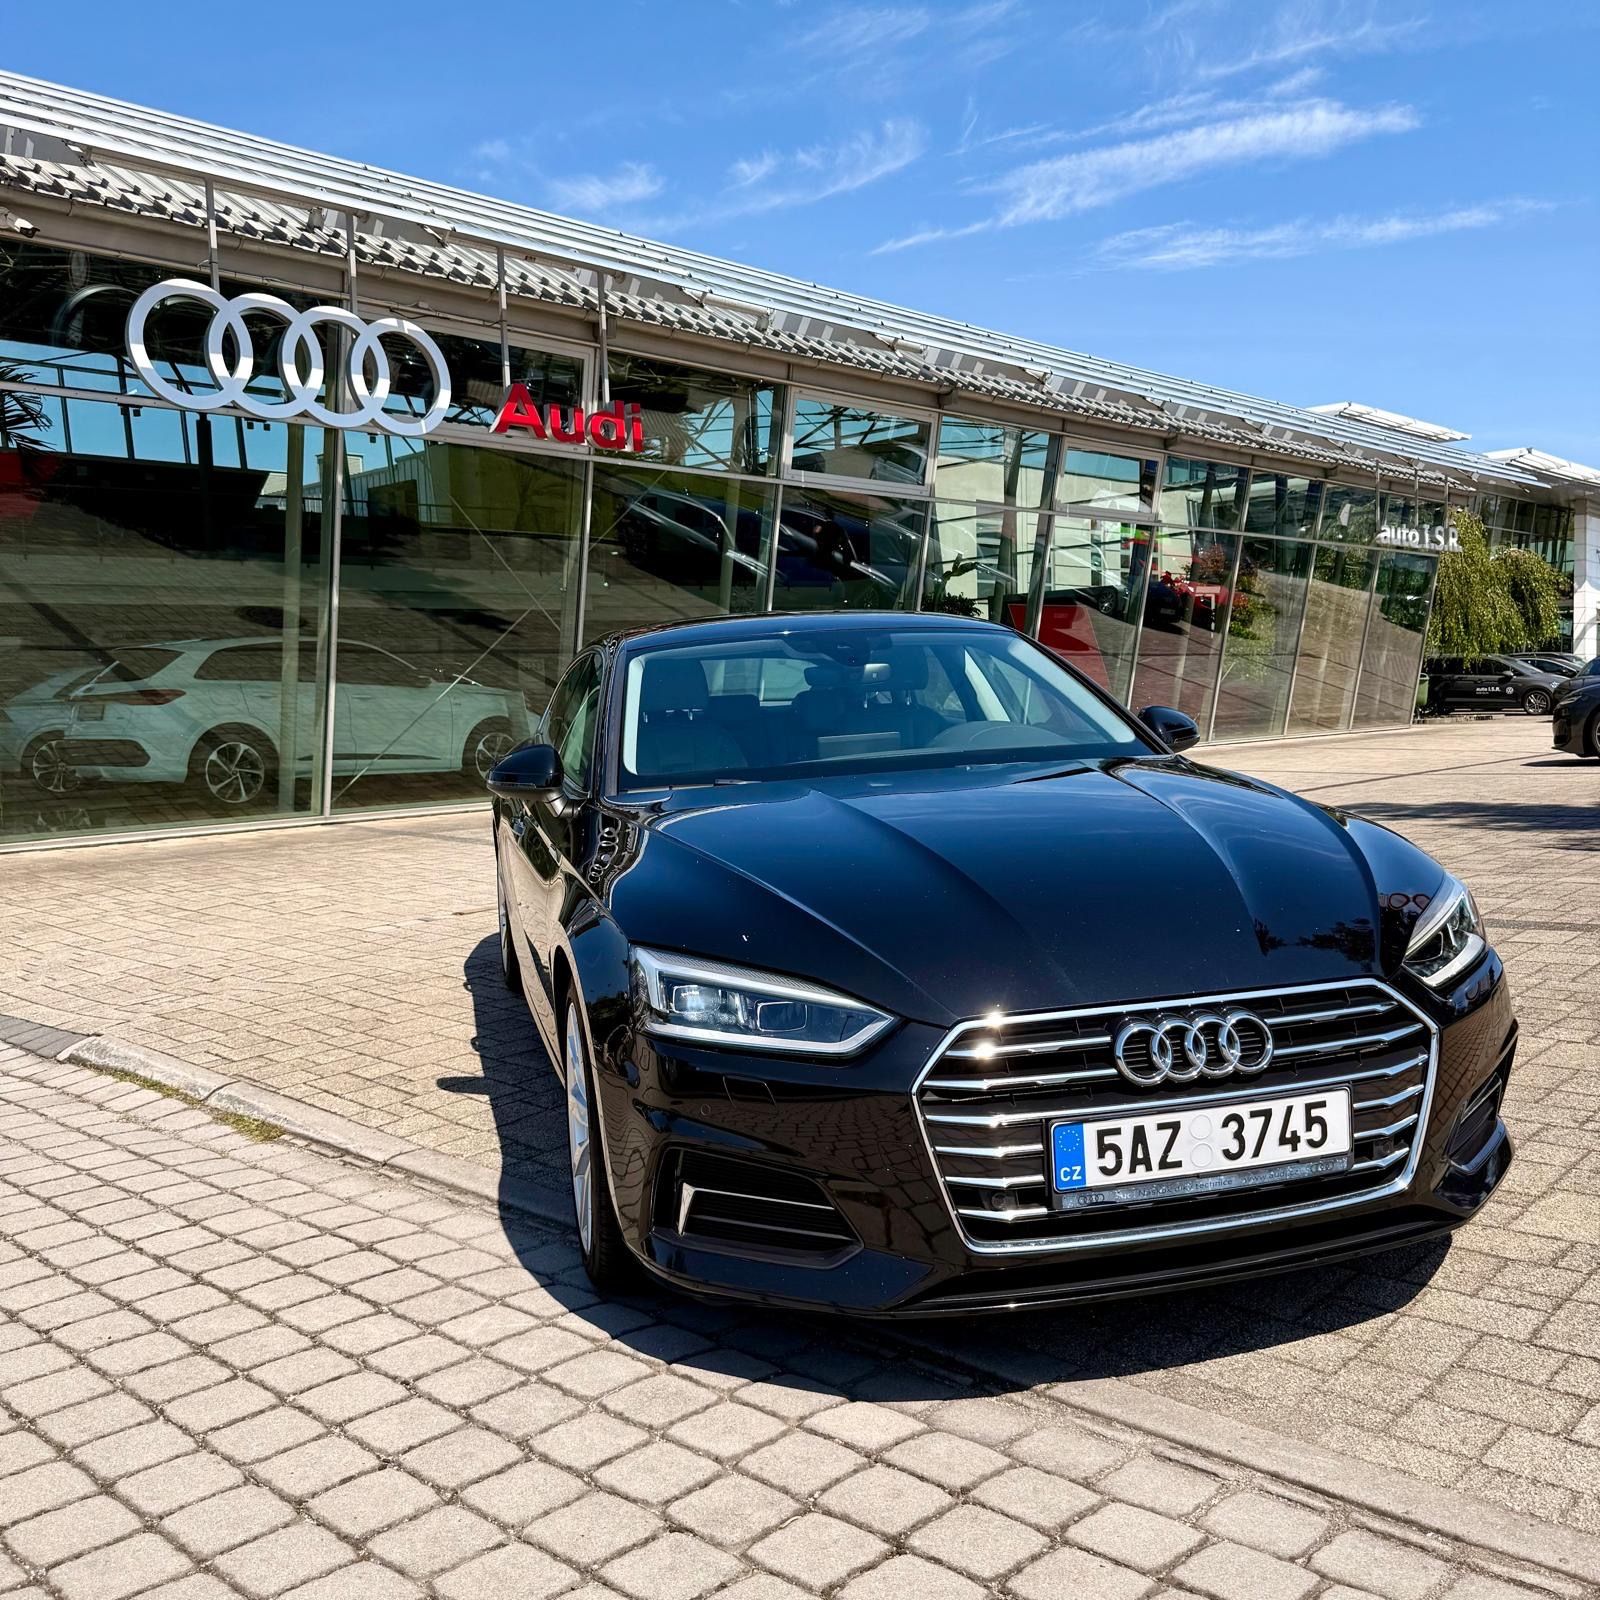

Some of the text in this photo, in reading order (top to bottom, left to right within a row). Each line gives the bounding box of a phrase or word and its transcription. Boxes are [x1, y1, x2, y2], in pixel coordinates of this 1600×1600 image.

[490, 383, 645, 452] Audi
[1377, 523, 1420, 548] auto
[1096, 1100, 1328, 1177] 5AZ 3745
[1060, 1166, 1082, 1181] CZ
